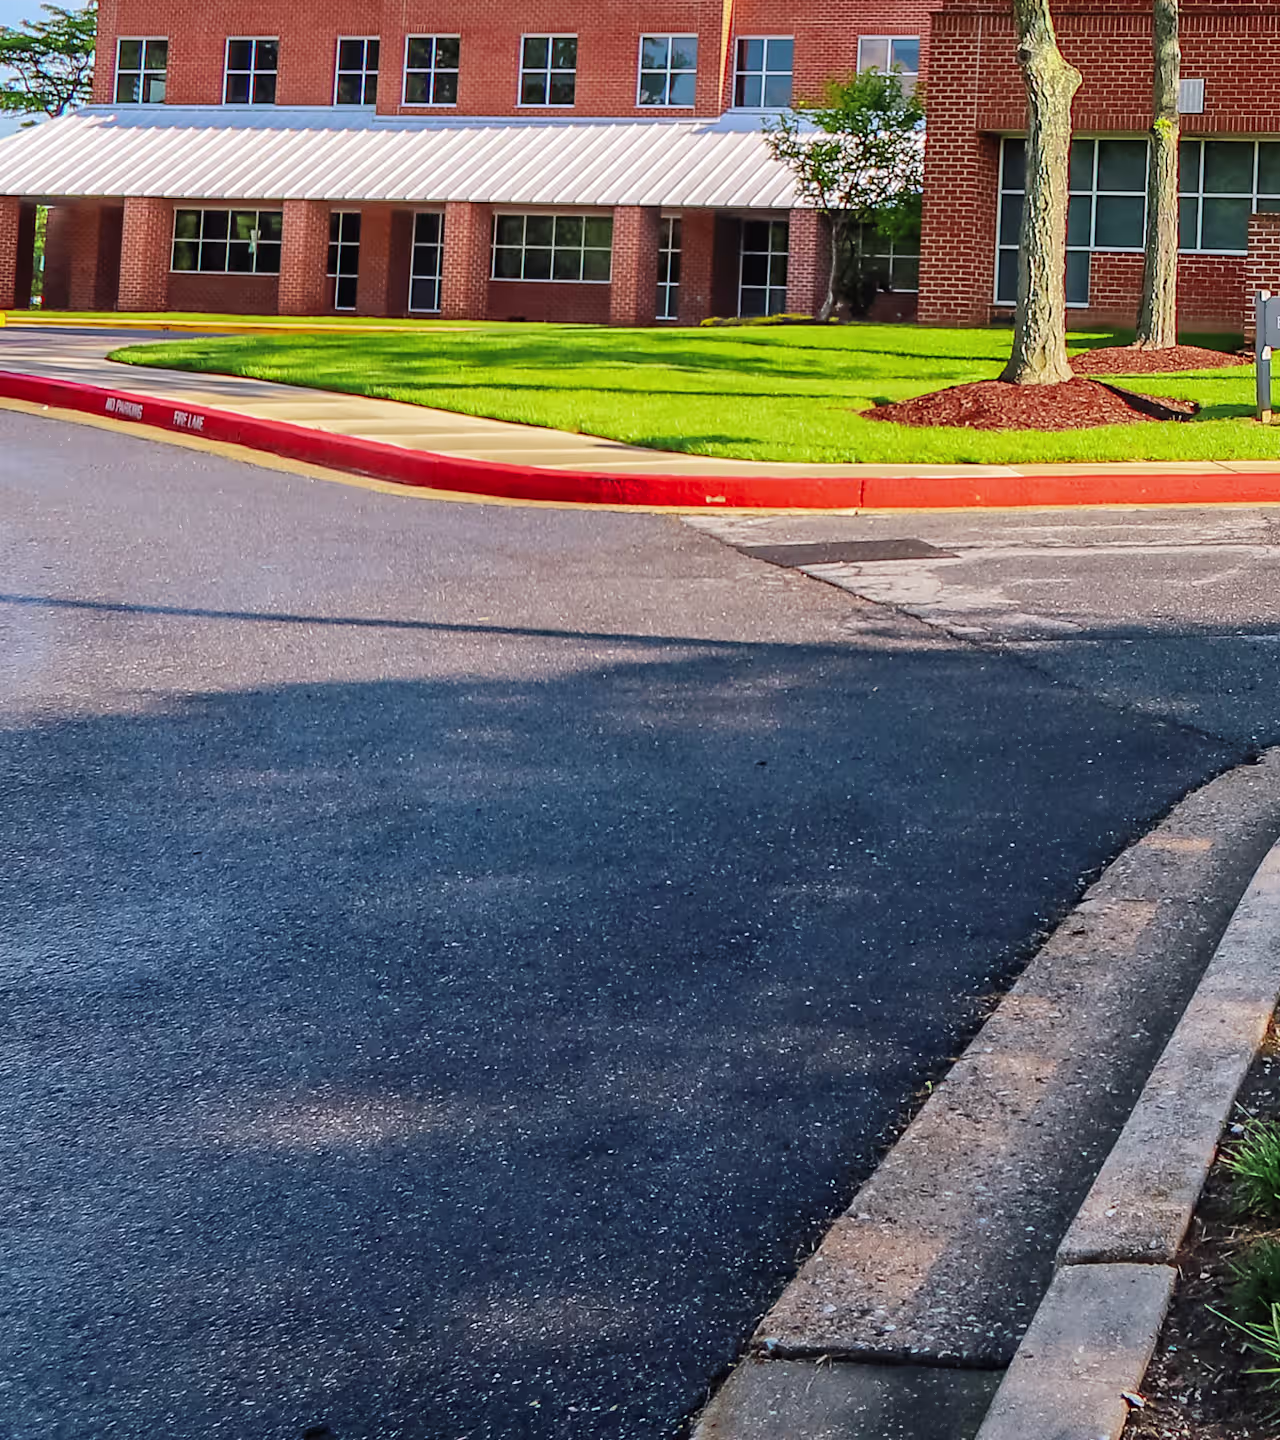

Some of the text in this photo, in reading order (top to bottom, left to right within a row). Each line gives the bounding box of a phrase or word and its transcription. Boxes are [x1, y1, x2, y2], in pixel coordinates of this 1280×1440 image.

[105, 397, 204, 430] NO PARKING FIRE LANE
